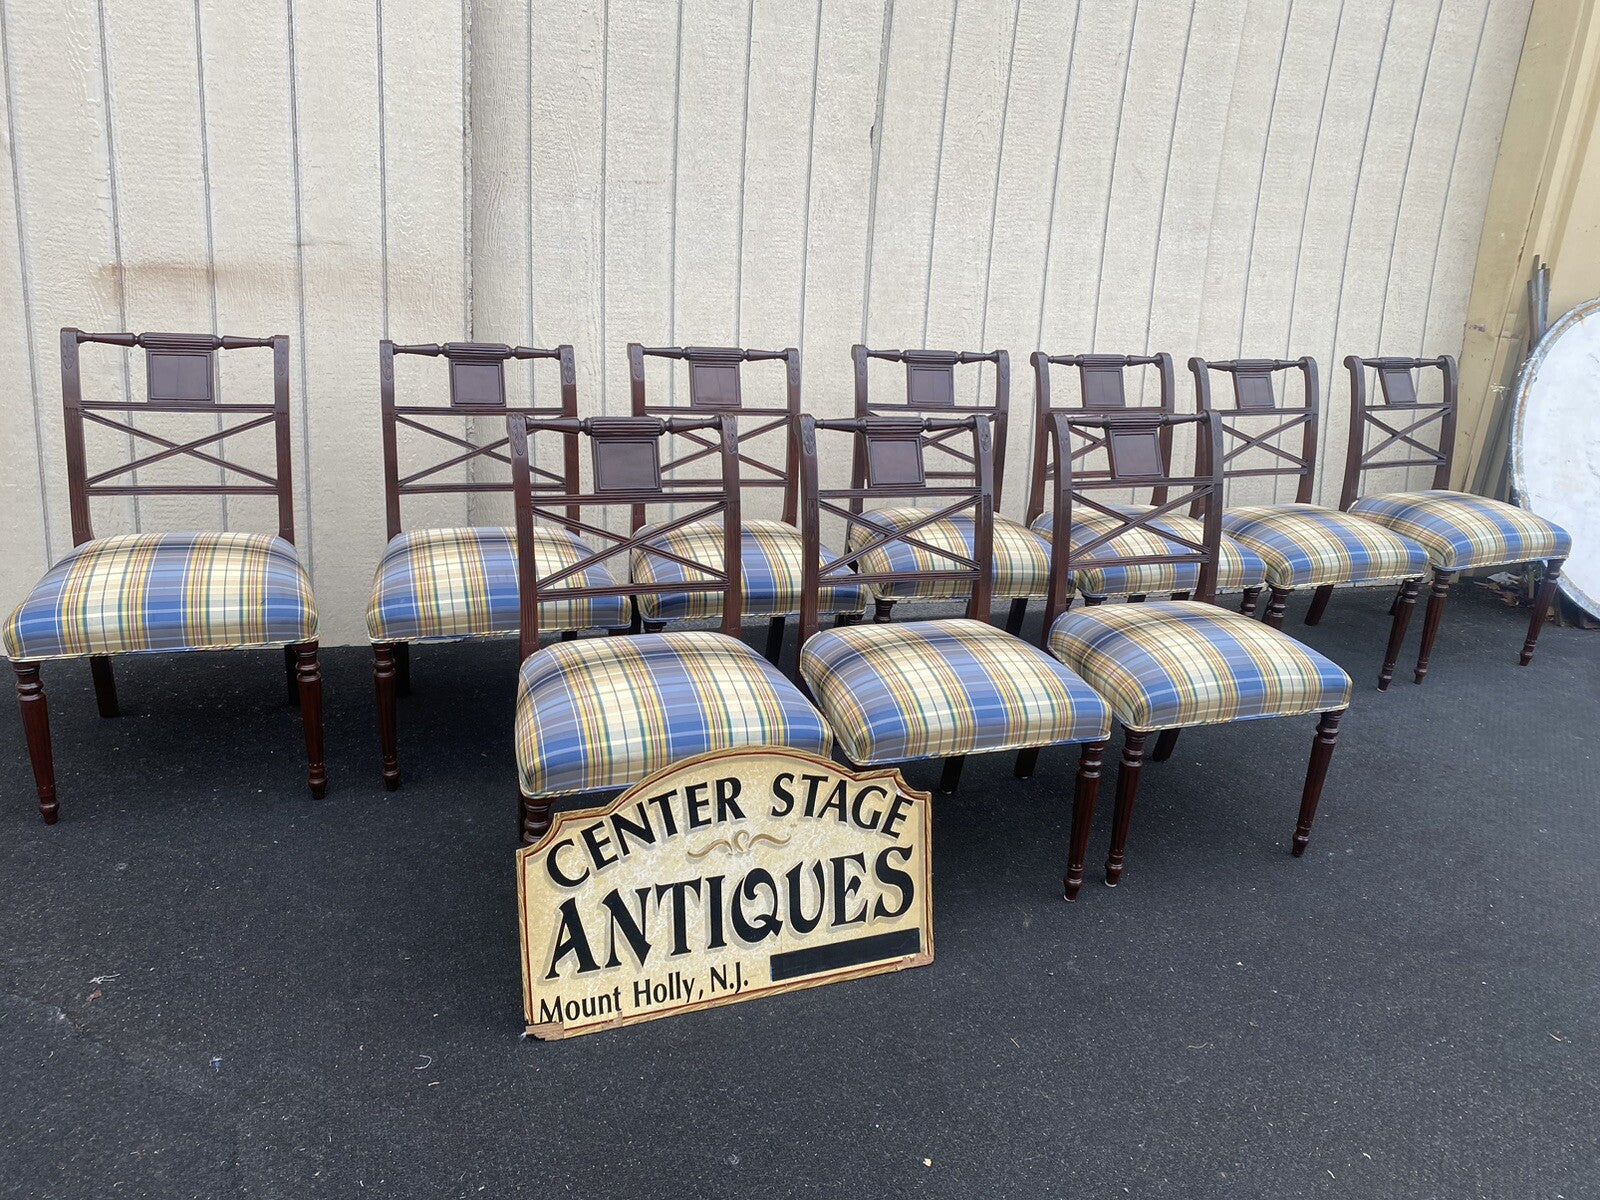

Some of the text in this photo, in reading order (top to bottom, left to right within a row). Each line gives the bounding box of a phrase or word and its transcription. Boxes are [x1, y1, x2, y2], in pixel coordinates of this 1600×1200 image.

[547, 773, 914, 887] CENTER STAGE
[545, 846, 915, 979] ANTIQUES
[539, 984, 622, 1023] Mount
[711, 961, 749, 994] N.J.
